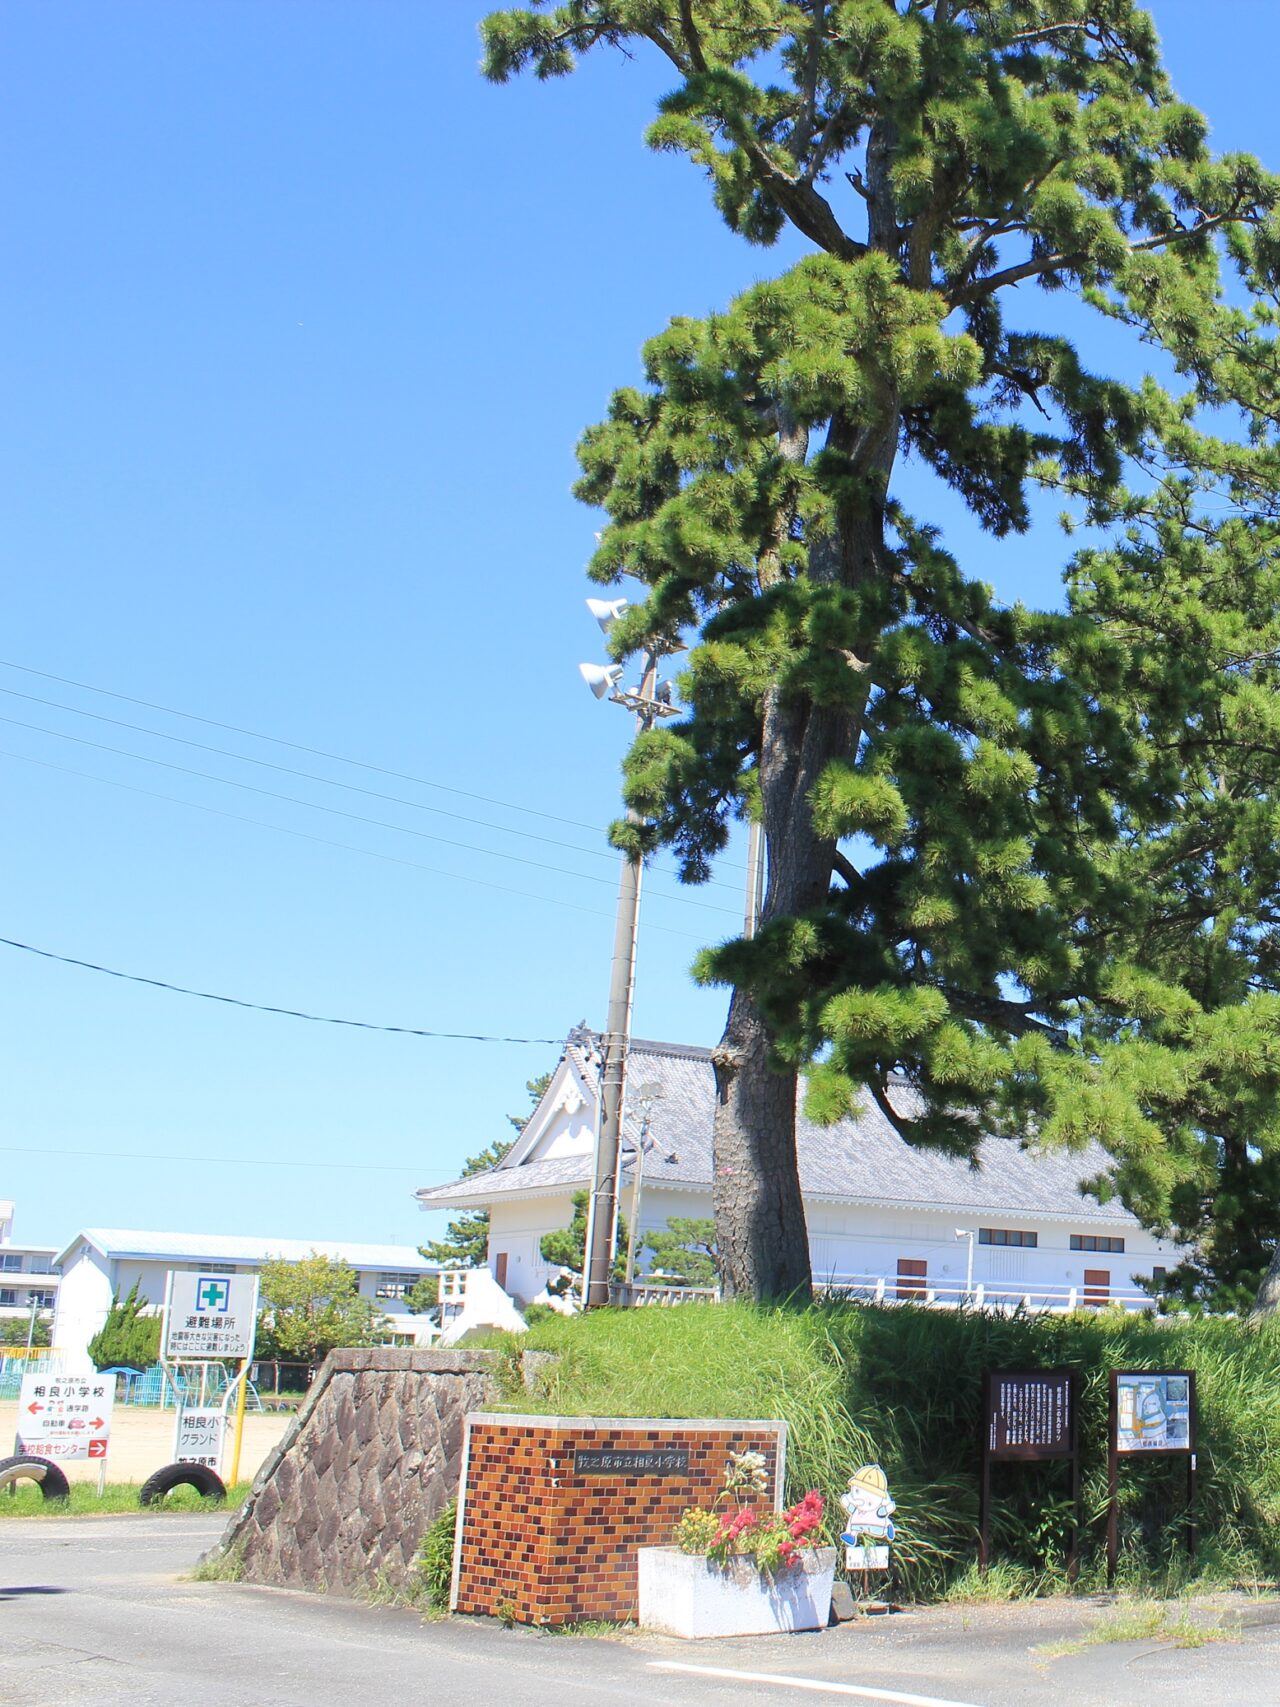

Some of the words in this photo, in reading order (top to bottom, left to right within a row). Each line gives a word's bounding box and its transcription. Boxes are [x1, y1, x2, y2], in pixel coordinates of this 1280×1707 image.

[185, 1316, 236, 1329] 避難場所
[34, 1386, 105, 1398] 相良小学校
[183, 1416, 219, 1429] 相良小
[181, 1433, 217, 1446] グランド
[19, 1443, 87, 1455] 学校給食センター
[577, 1455, 688, 1469] 牧之原市立相良小学校
